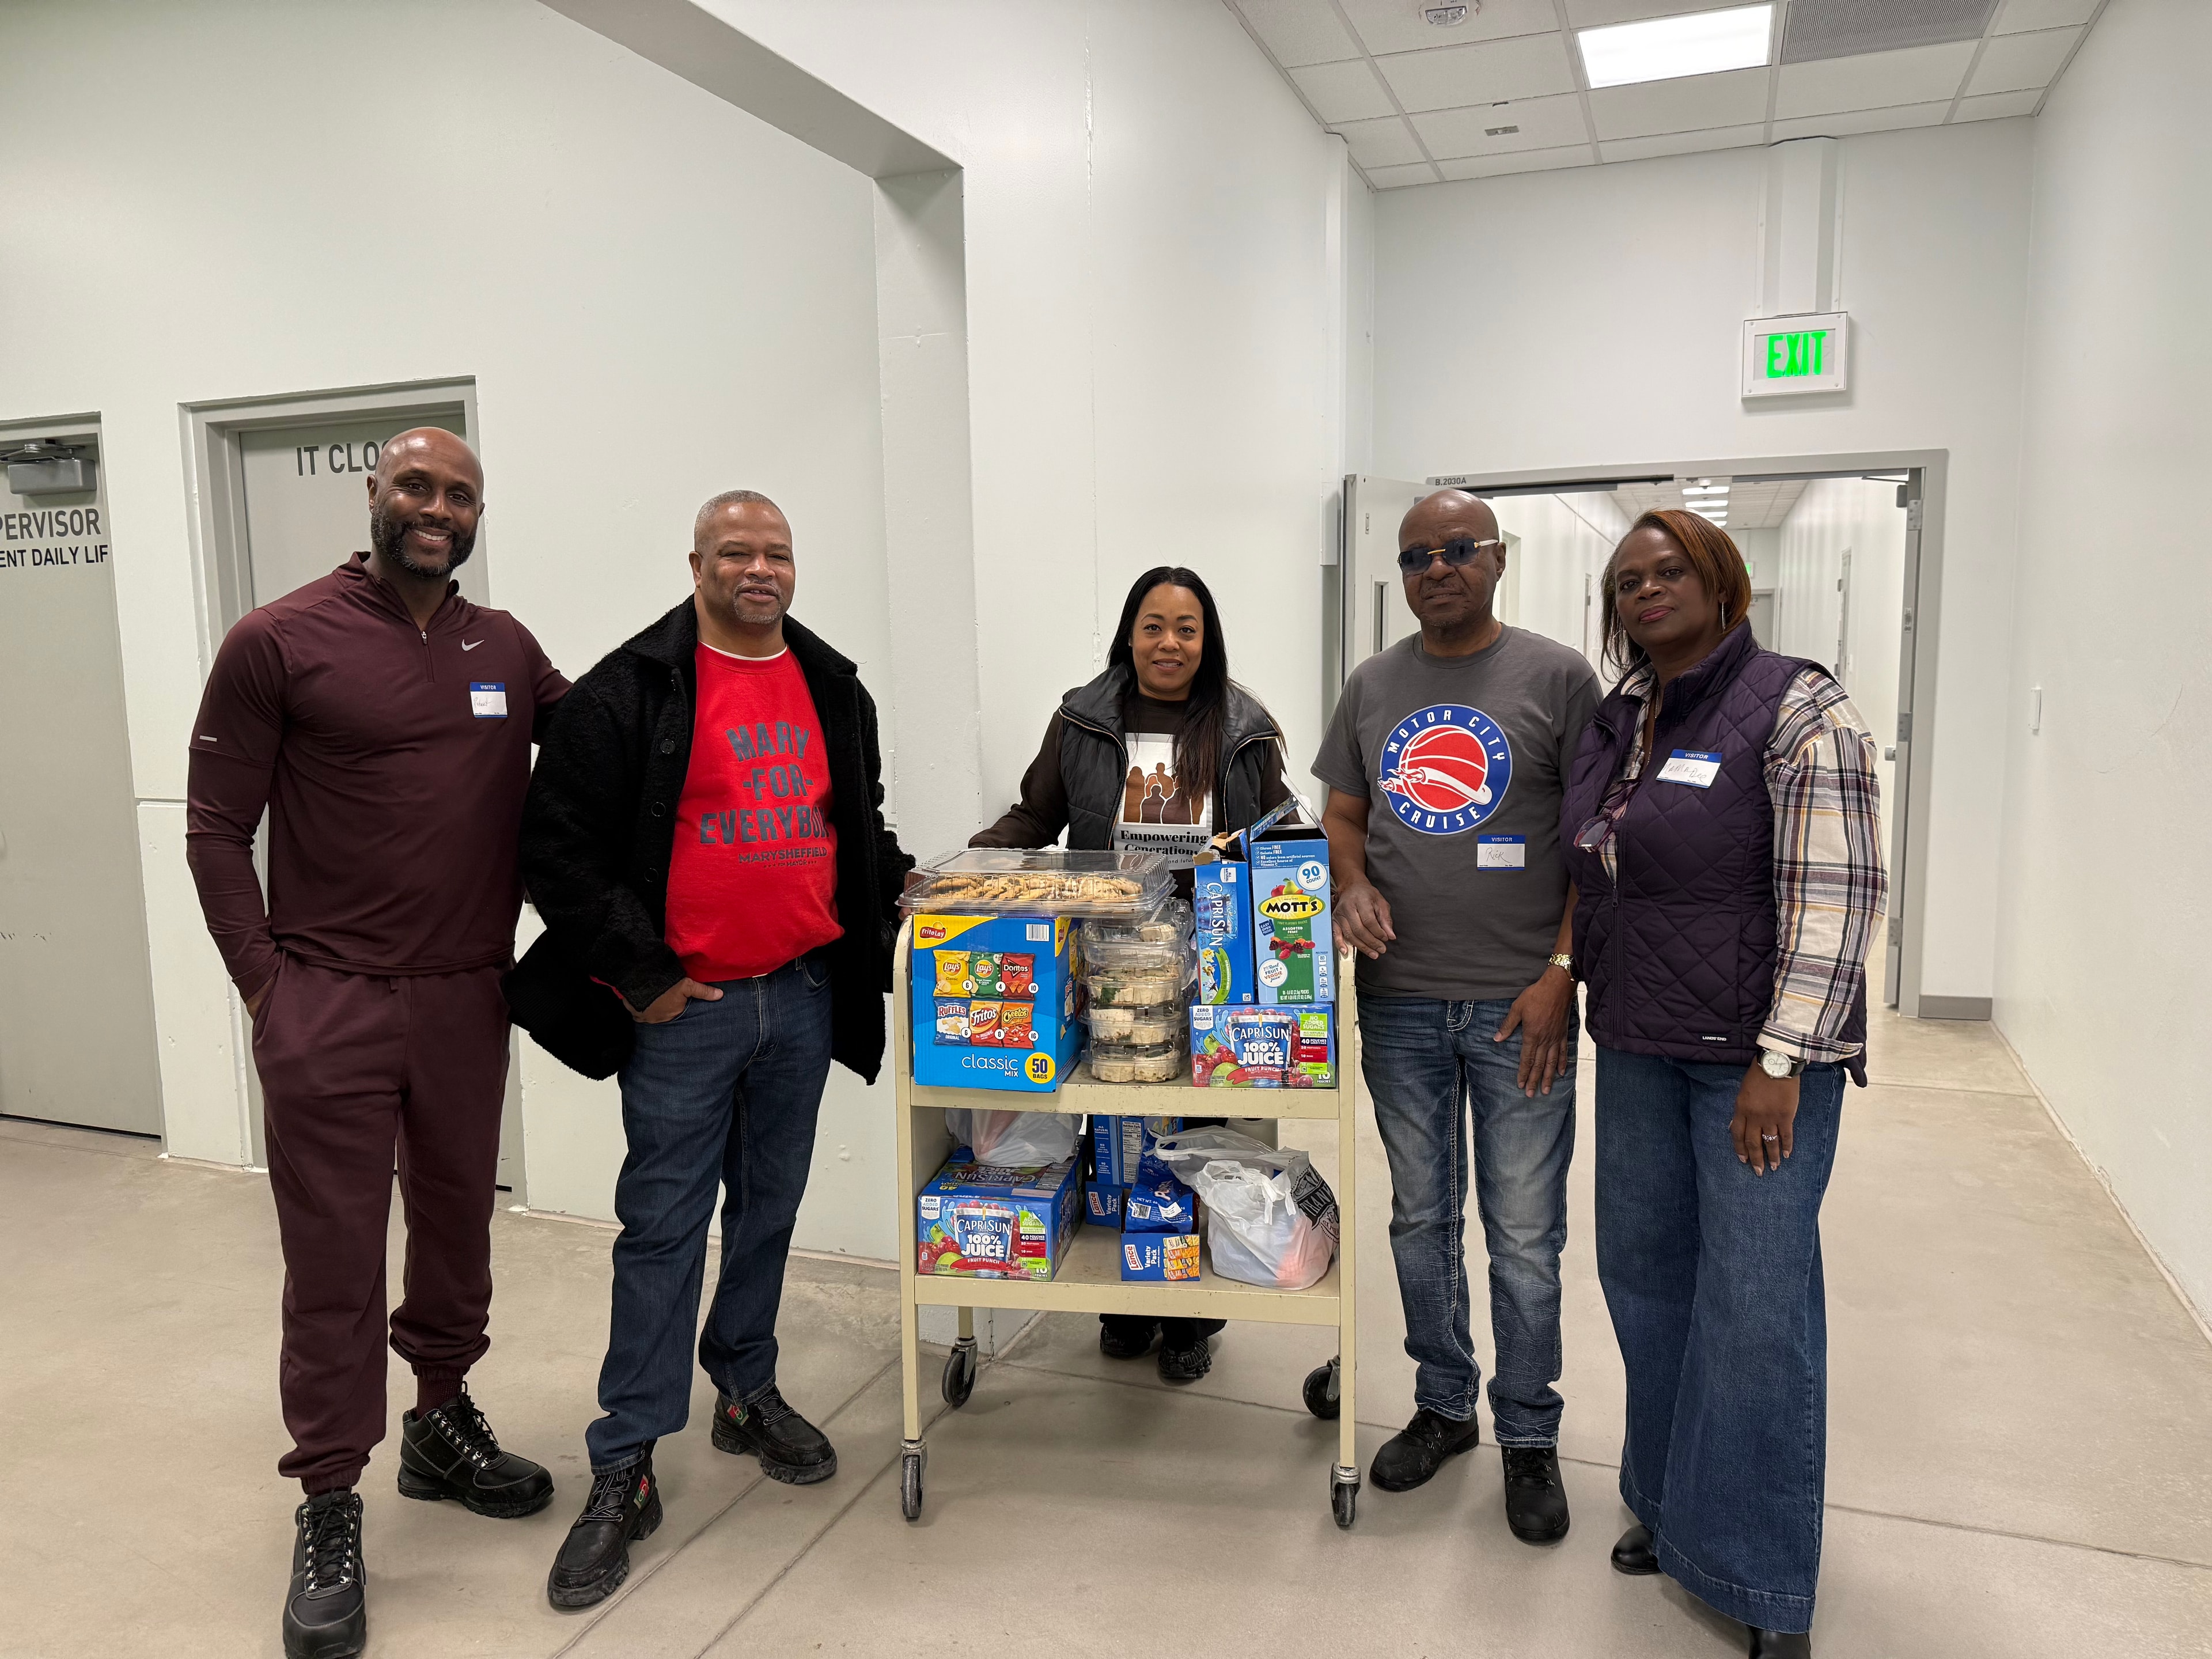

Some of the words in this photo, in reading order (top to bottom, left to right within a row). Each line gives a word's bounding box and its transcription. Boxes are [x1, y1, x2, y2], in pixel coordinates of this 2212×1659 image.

[1767, 331, 1827, 378] EXIT
[297, 446, 319, 476] IT
[329, 440, 390, 474] CLO
[1435, 477, 1467, 486] B.2030A
[0, 508, 101, 540] ERVISOR
[32, 546, 79, 566] DAILY
[85, 544, 108, 563] LIF
[726, 721, 810, 762] MARY
[1387, 710, 1452, 754] MOTOR
[1468, 716, 1505, 761] CITY
[1399, 801, 1480, 830] CRUISE
[1120, 830, 1209, 846] Empowering
[1302, 865, 1320, 879] 90
[944, 962, 960, 972] Lay's
[976, 964, 993, 974] Lay's
[1003, 964, 1028, 972] Doritos
[1264, 971, 1283, 979] VEGGIE
[938, 1006, 965, 1017] RUFFLES
[971, 1008, 997, 1026] Fritos
[1003, 1008, 1028, 1023] Cheetos
[1244, 1042, 1281, 1052] 100%
[961, 1053, 1018, 1070] classic
[1032, 1058, 1048, 1074] 50
[1237, 1052, 1284, 1065] JUICE
[1090, 1192, 1101, 1214] Lance
[967, 1234, 1002, 1245] 100%
[961, 1244, 1005, 1257] JUICE
[1127, 1246, 1139, 1269] Lance
